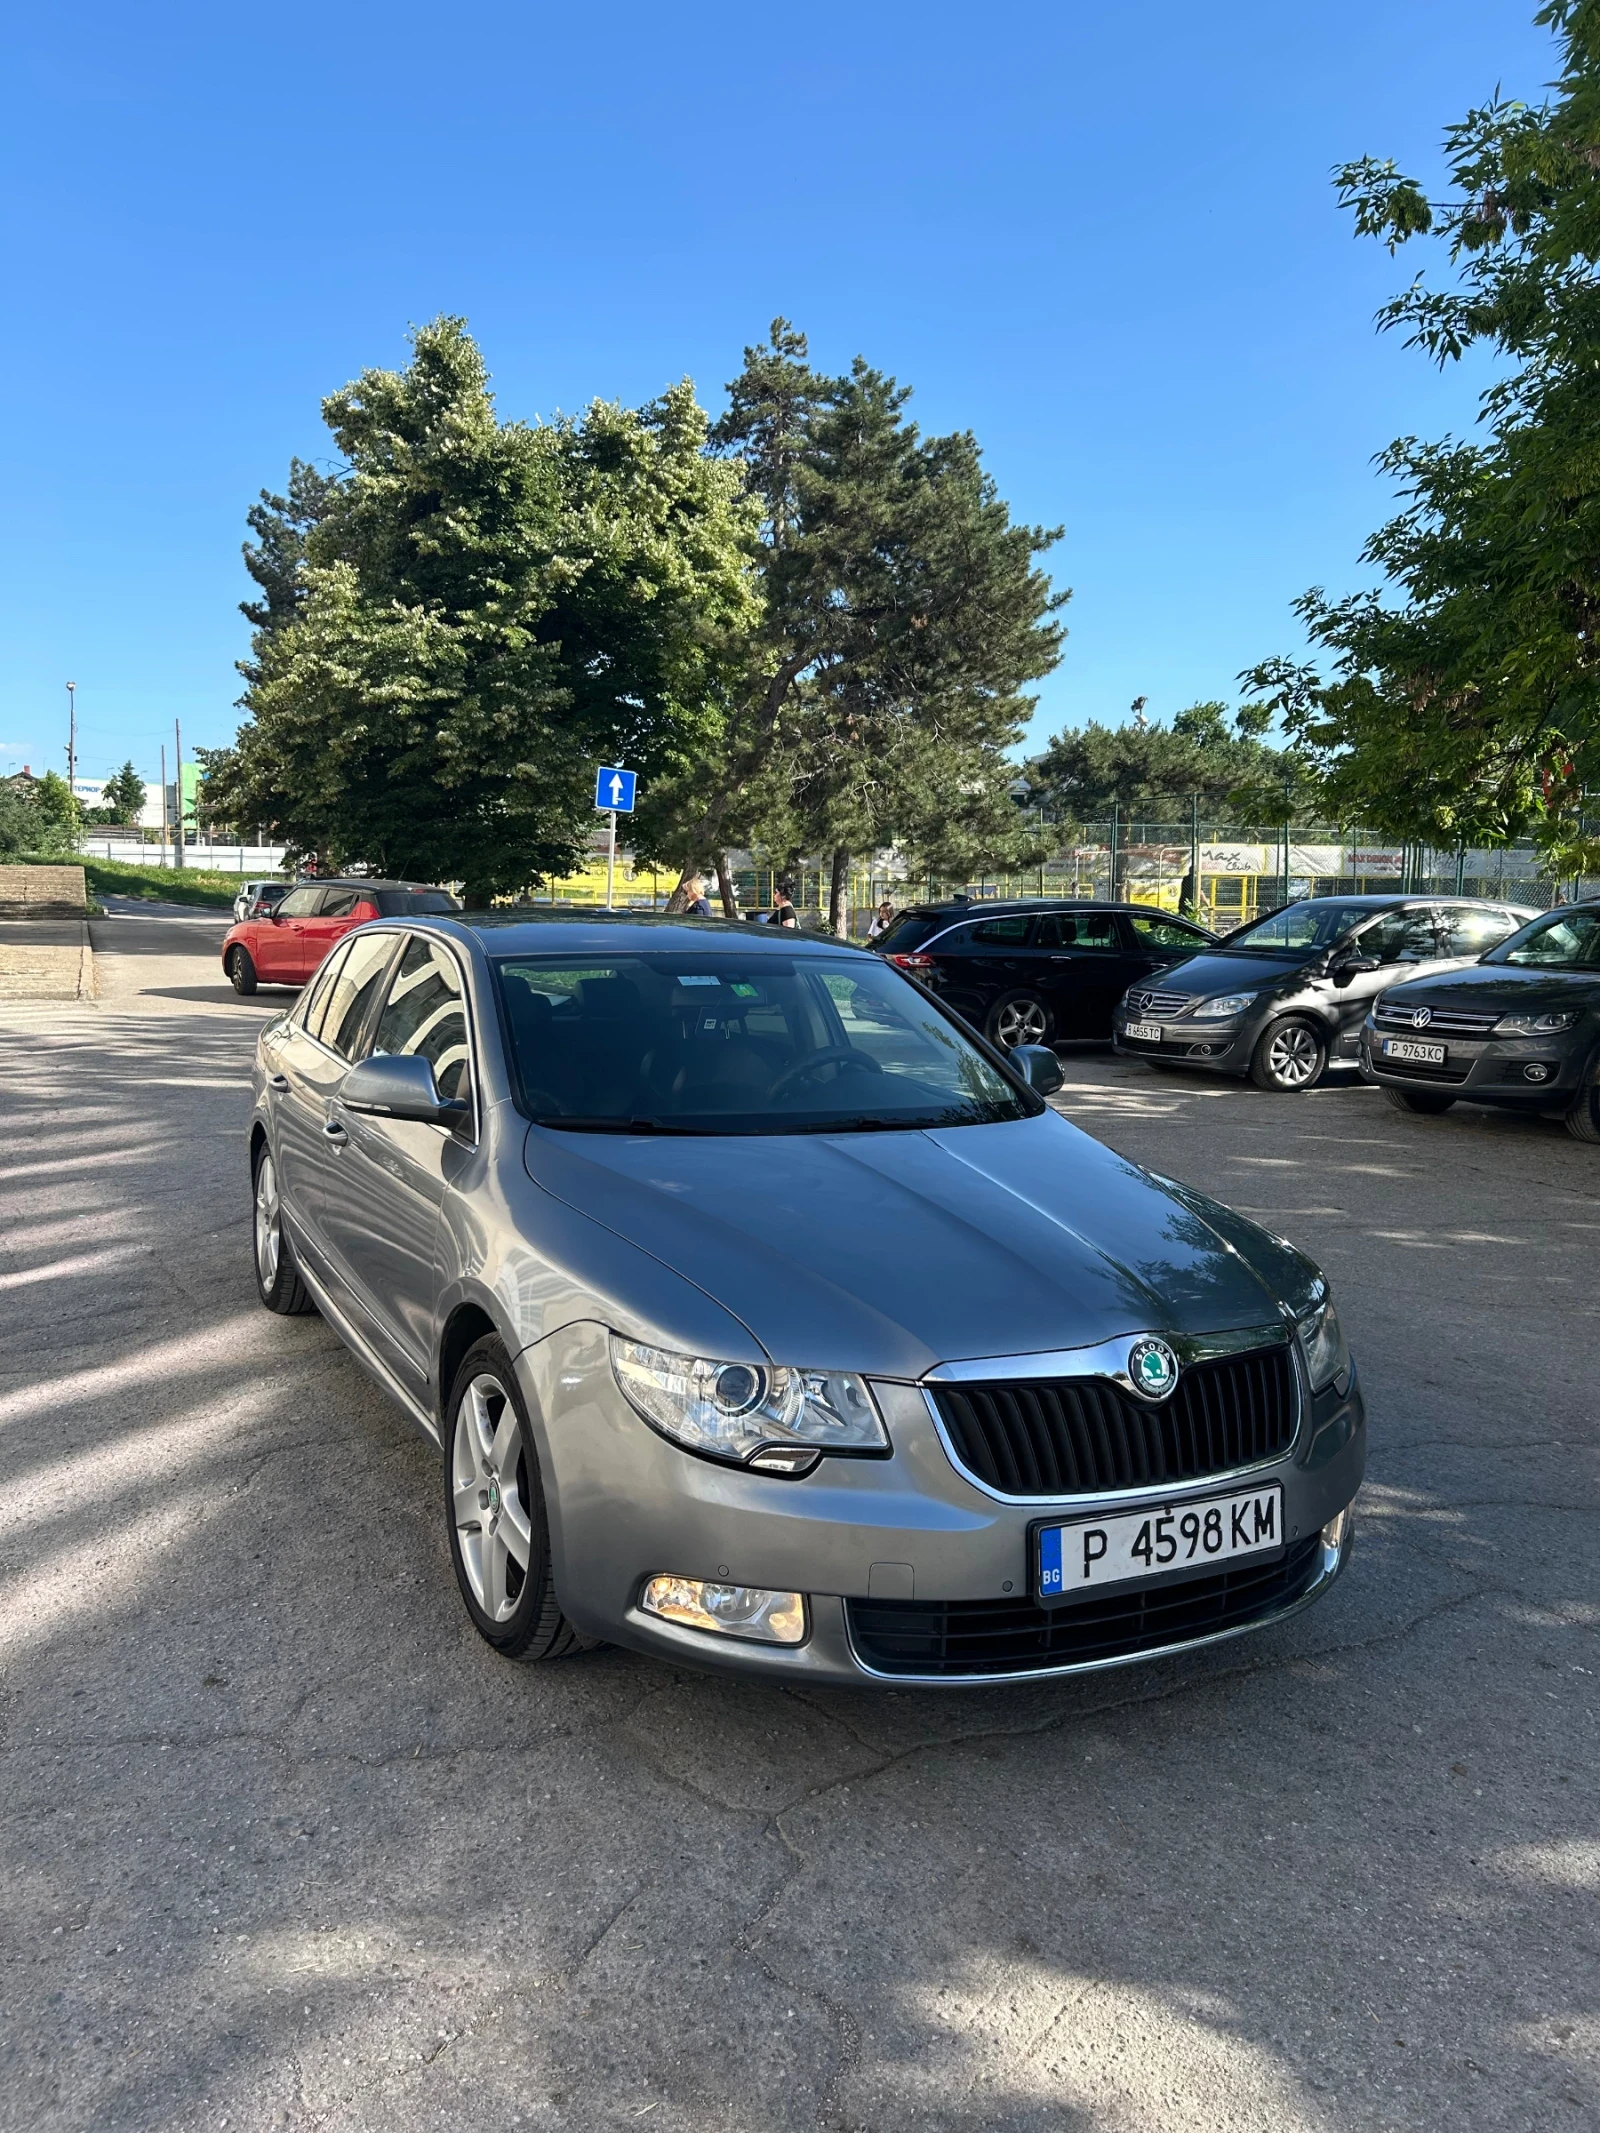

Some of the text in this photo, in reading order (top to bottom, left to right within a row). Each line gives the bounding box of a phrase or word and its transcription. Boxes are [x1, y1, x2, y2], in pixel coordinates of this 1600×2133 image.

[1391, 1043, 1399, 1055] P
[1082, 1528, 1109, 1579] P
[1042, 1568, 1061, 1586] BG
